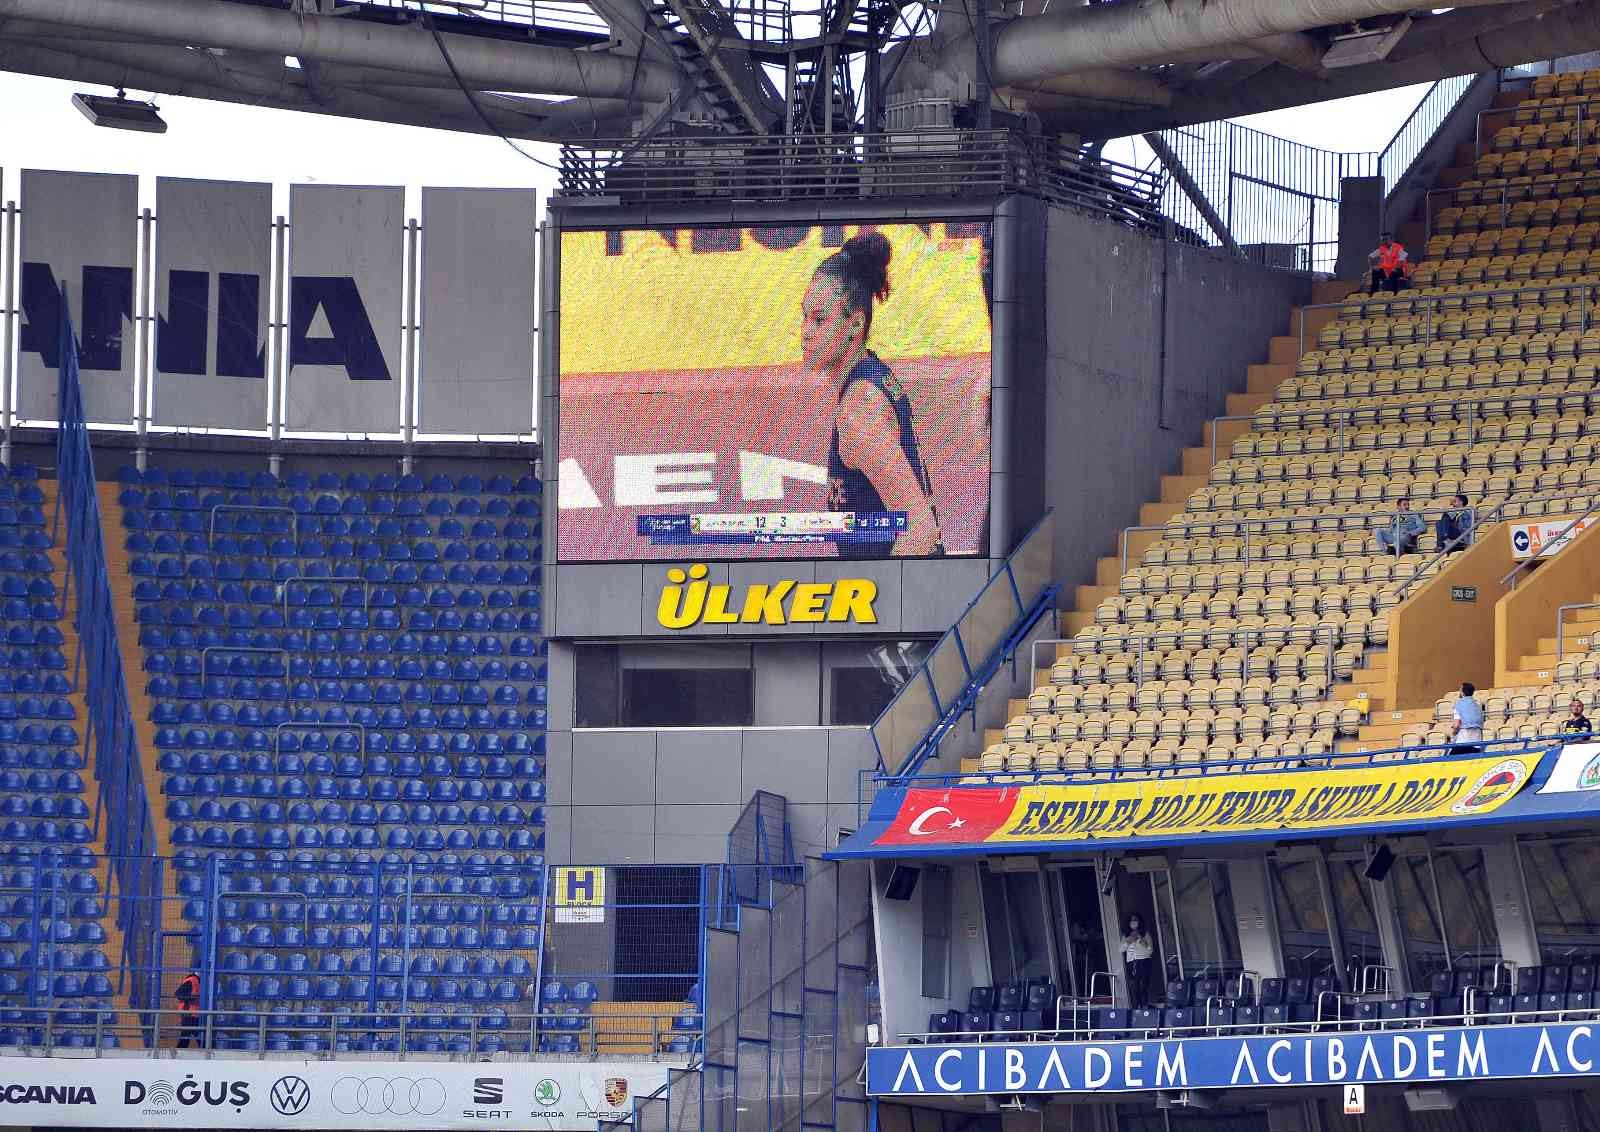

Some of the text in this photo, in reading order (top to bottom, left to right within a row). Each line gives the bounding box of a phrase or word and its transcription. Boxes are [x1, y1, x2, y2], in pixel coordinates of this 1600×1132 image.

[656, 563, 879, 629] ÜLKER
[567, 870, 594, 900] H
[892, 1027, 1593, 1092] ACIBADEM ACIBADEM AC
[124, 1074, 249, 1113] DOĞUŞ
[1349, 1087, 1358, 1105] A
[463, 1110, 513, 1119] SEAT
